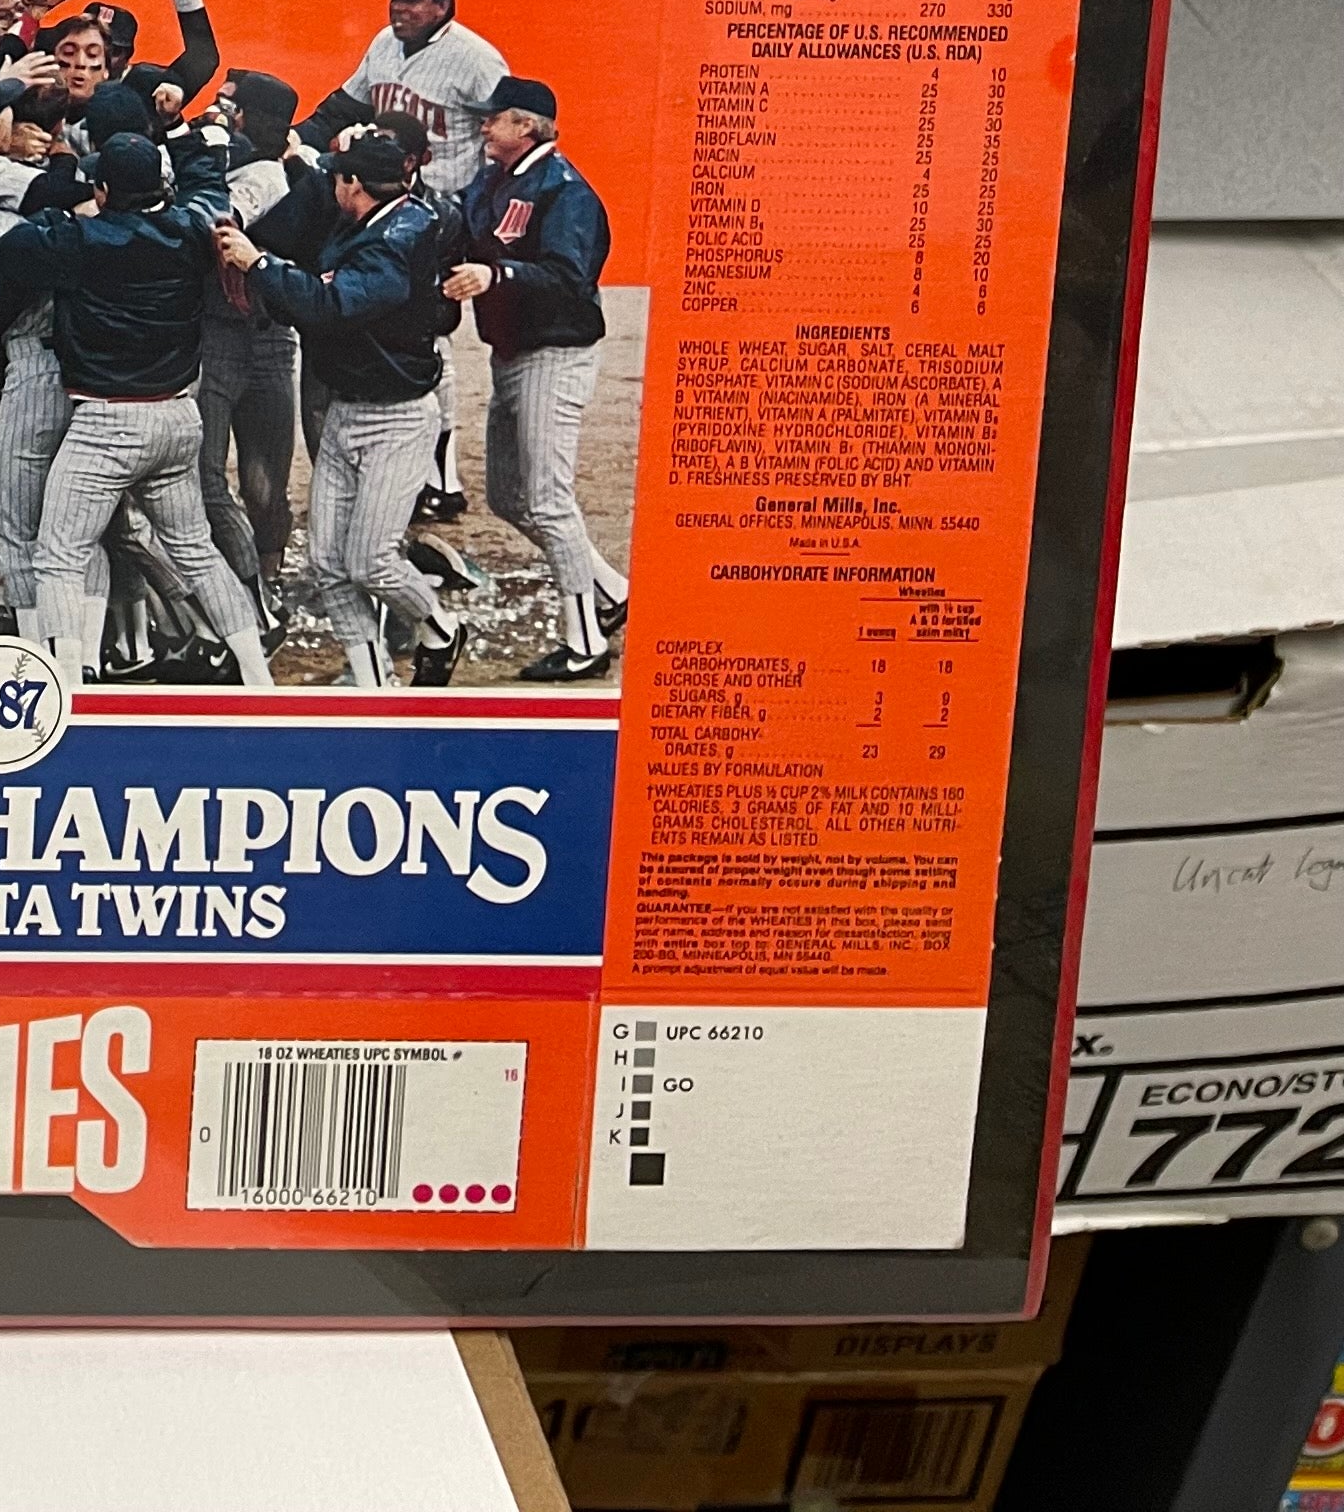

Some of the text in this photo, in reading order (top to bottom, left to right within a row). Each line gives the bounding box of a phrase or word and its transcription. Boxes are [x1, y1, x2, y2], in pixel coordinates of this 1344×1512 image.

[796, 324, 891, 340] INGREDIENTS
[755, 496, 902, 515] General Mills, Inc.
[710, 564, 936, 584] CARBOHYDRATE INFORMATION
[72, 884, 286, 940] TWINS
[258, 1047, 448, 1061] 18 OZ WHEATIES UPC SYMBOL
[663, 1077, 694, 1092] GO
[242, 1189, 377, 1206] 16000 66210
[834, 1334, 995, 1358] DISPLAYS
